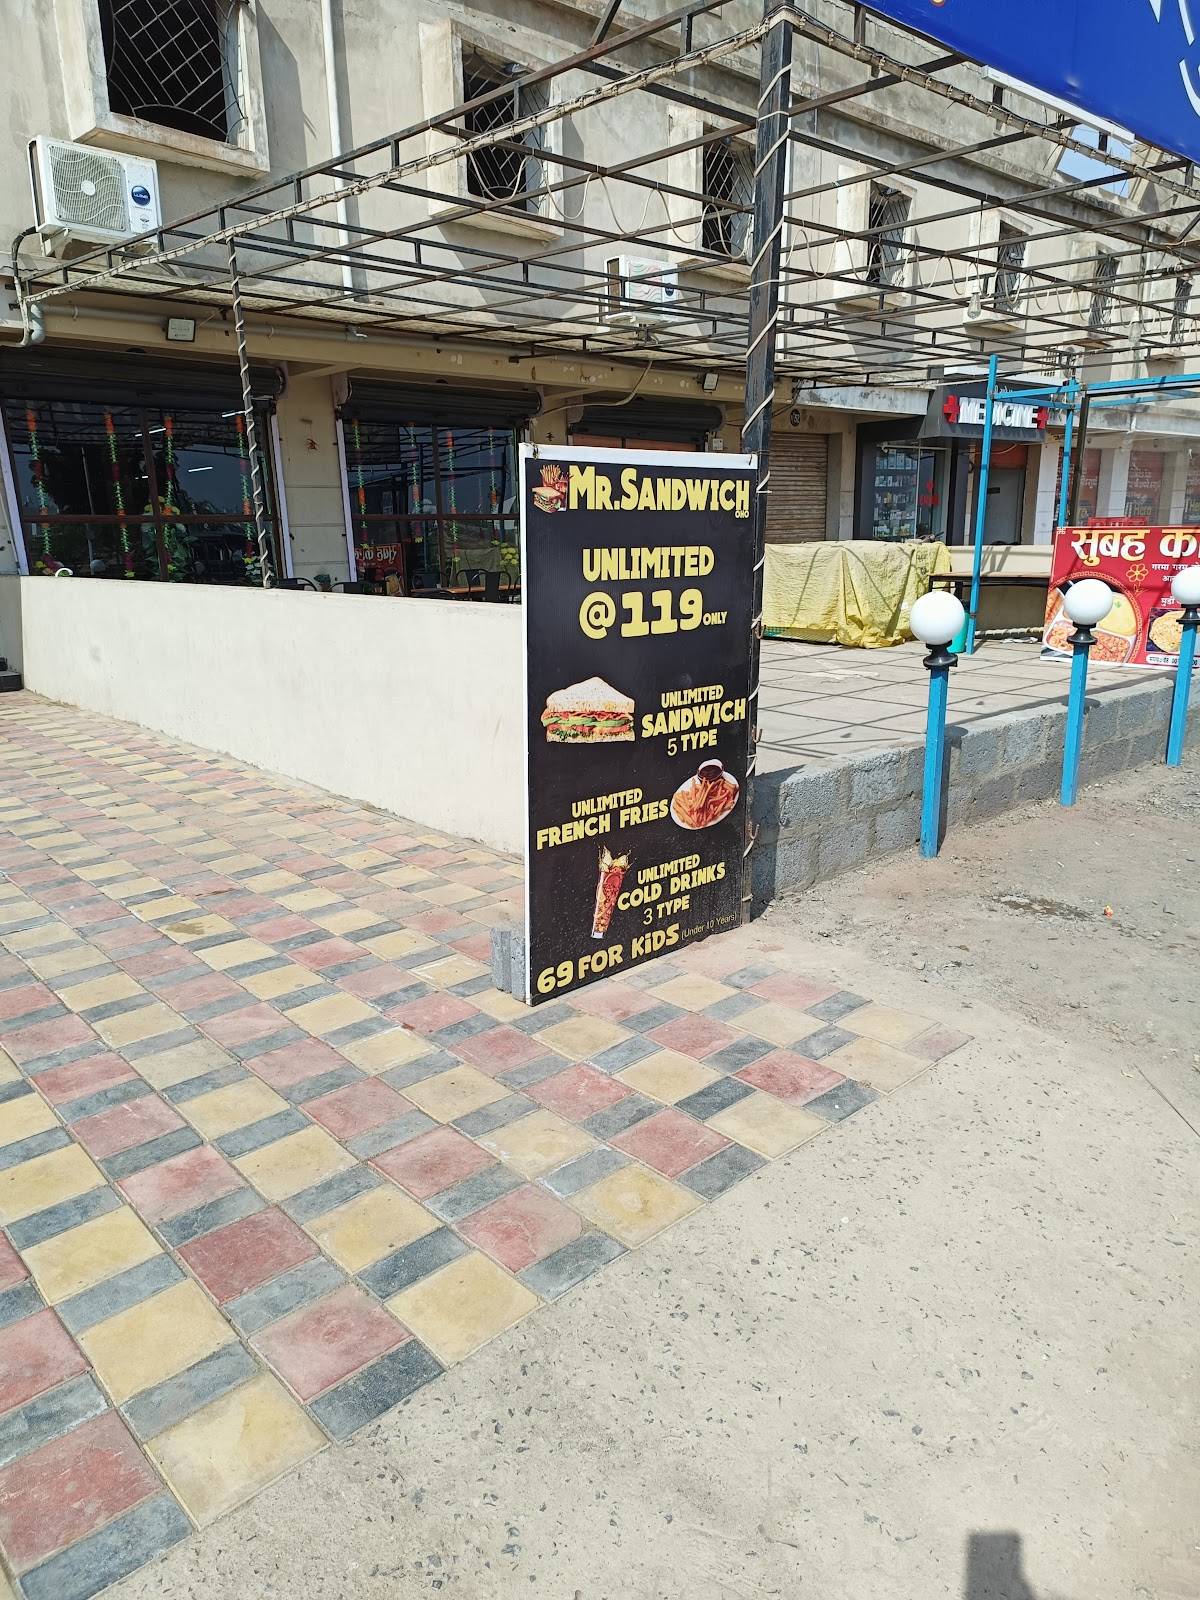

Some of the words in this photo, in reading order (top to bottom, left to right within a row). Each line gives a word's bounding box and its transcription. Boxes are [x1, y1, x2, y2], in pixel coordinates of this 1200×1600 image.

[582, 545, 715, 582] UNLIMITED
[1071, 529, 1151, 567] सुबह
[578, 588, 704, 640] @119
[702, 611, 728, 626] ONLY
[661, 684, 724, 708] UNLIMITED
[641, 697, 747, 739] SANDWICH
[667, 738, 678, 756] 5
[681, 728, 718, 753] TYPE
[571, 788, 643, 819] UNLIMITED
[536, 814, 611, 850] FRENCH
[619, 798, 669, 829] FRIES
[617, 882, 662, 912] COLD
[670, 862, 726, 897] DRINKS
[637, 853, 701, 884] UNLIMITED
[643, 907, 653, 926] 3
[657, 894, 691, 920] TYPE
[536, 959, 575, 994] 69
[578, 942, 624, 981] FOR
[706, 920, 716, 933] 10
